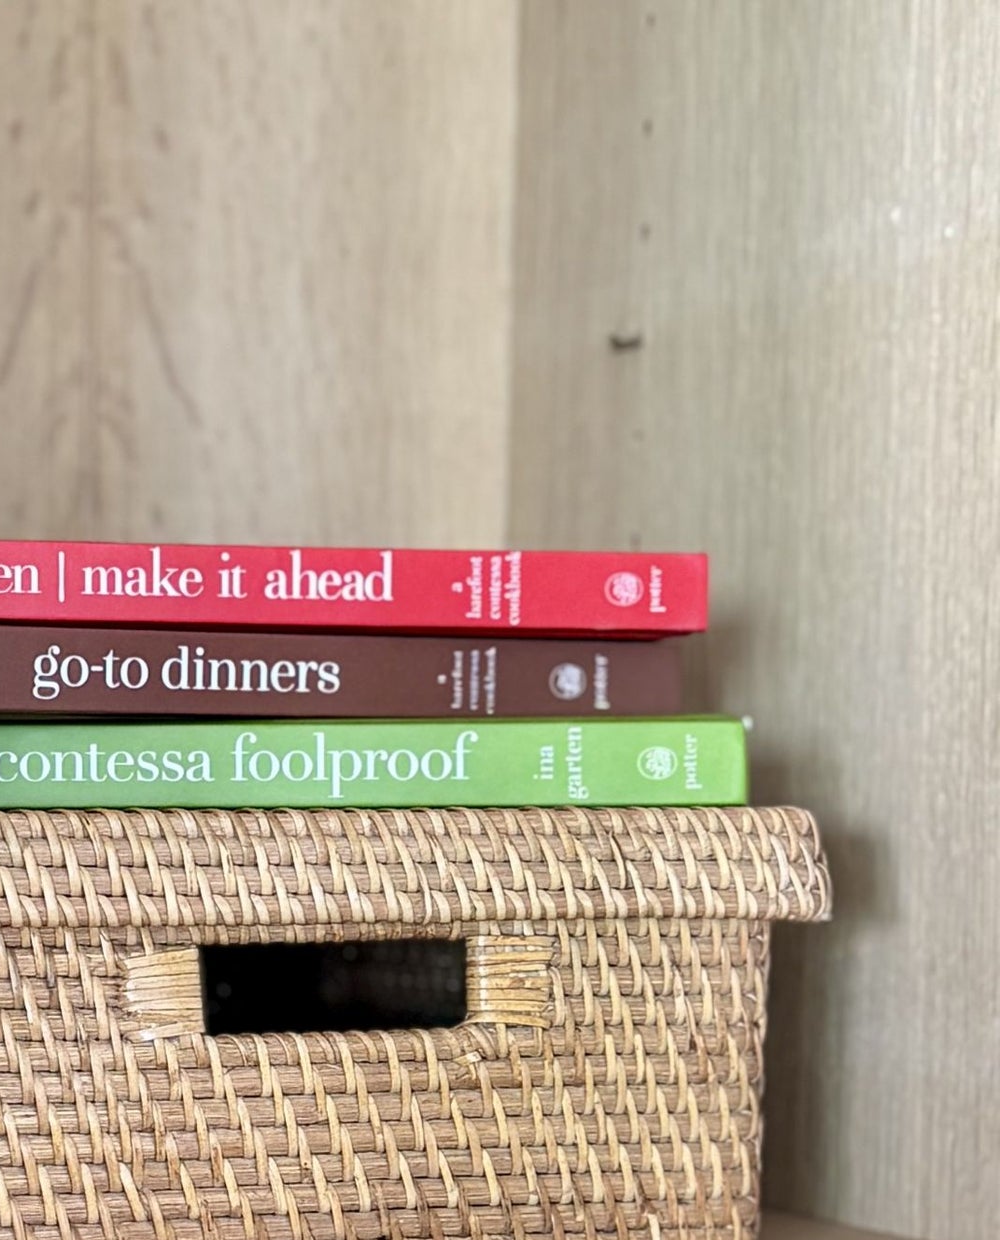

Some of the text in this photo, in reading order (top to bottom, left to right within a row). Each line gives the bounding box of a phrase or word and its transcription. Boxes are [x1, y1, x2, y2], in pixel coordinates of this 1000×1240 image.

[81, 546, 204, 598] make
[216, 552, 248, 598] it
[264, 549, 394, 601] ahead
[32, 645, 341, 700] go-to dinners
[230, 730, 479, 798] foolproof
[533, 745, 554, 780] ina
[566, 726, 589, 799] garten
[684, 733, 702, 790] potter
